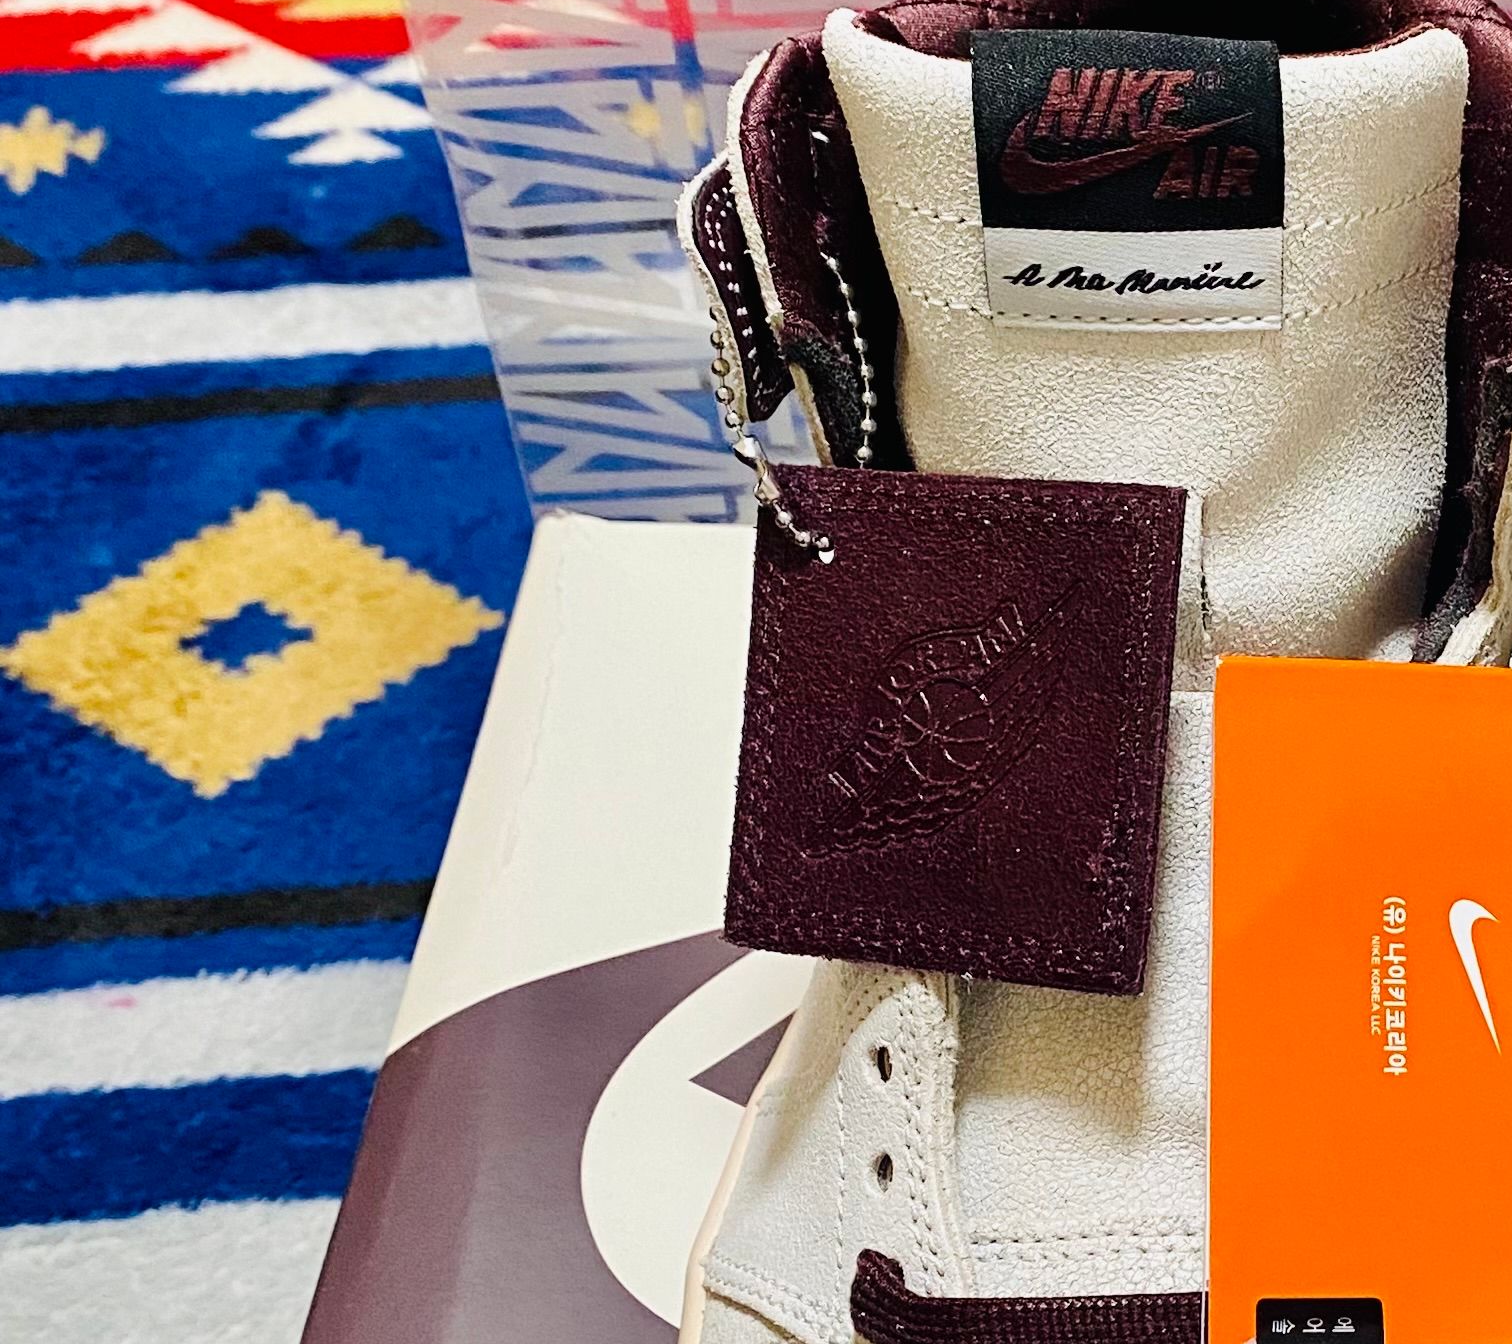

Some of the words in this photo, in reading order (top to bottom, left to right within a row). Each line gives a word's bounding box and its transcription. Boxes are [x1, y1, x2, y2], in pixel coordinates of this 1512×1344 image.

[1032, 67, 1196, 141] NIKE
[1153, 145, 1259, 199] AIR
[1383, 896, 1407, 935] (유)
[1370, 935, 1381, 965] NIKE
[1370, 968, 1381, 1012] KOREA
[1383, 942, 1408, 1076] 나이키코리아
[1370, 1014, 1382, 1037] LLC
